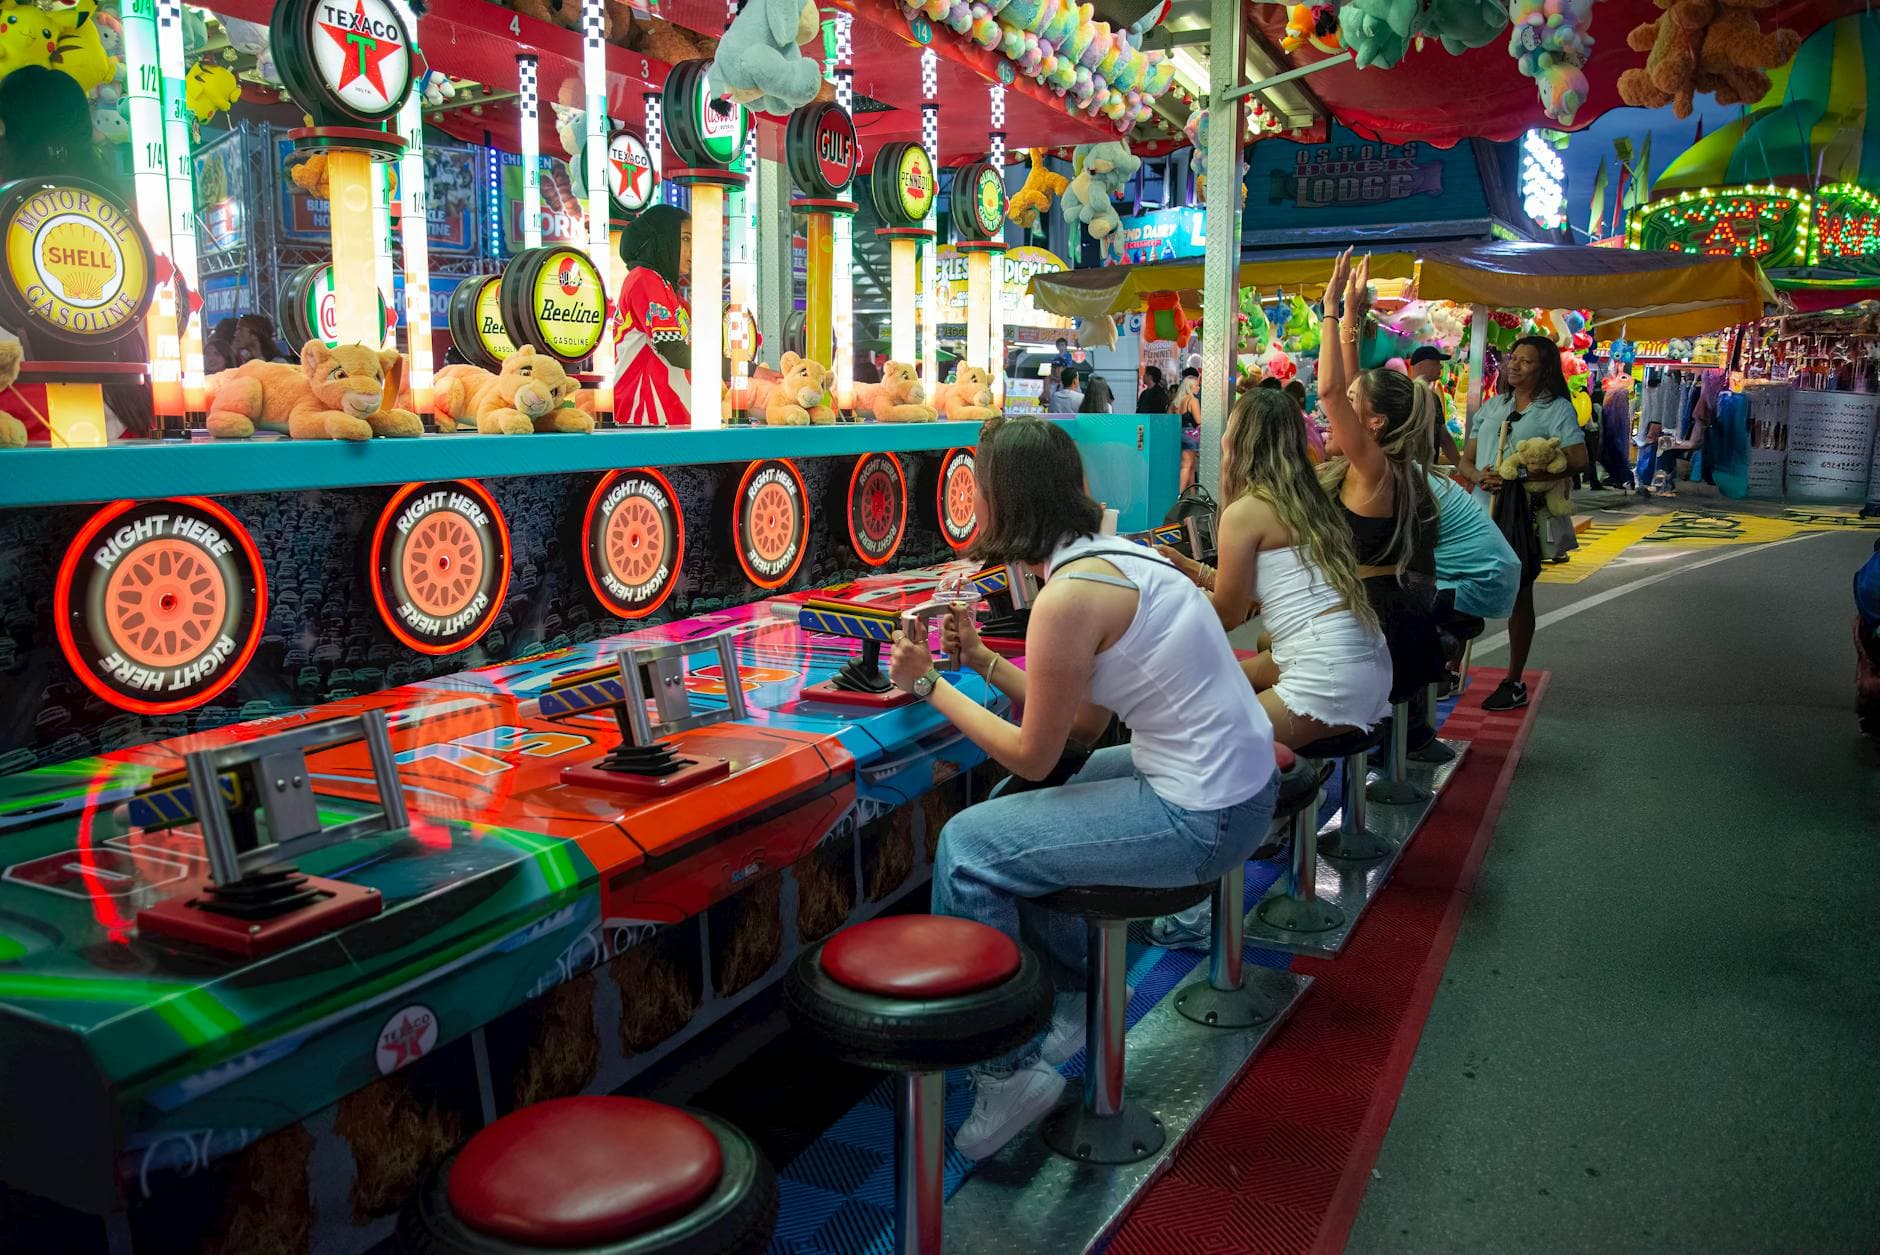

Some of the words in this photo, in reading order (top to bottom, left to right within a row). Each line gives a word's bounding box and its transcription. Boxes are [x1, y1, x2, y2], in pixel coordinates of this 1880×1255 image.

[324, 5, 398, 41] TEXACO
[510, 15, 521, 36] 4
[915, 21, 928, 41] 14
[140, 64, 157, 92] 1/2
[641, 60, 650, 78] 3
[999, 64, 1012, 81] 15
[146, 142, 163, 169] 1/4
[502, 154, 552, 169] CHIEN
[612, 148, 648, 166] TEXACO
[821, 130, 852, 168] GULF
[1296, 174, 1413, 208] LODGE
[16, 190, 92, 235] MOTOR
[97, 204, 130, 242] OIL
[48, 246, 111, 269] SHELL
[26, 284, 137, 331] GASOLINE
[541, 299, 600, 323] Beeline
[554, 337, 589, 346] GASOLINE
[748, 468, 775, 500] RIGHT
[775, 469, 797, 496] HERE
[860, 459, 880, 486] RIGHT
[881, 460, 898, 482] HERE
[601, 480, 638, 516] RIGHT
[639, 480, 669, 510] HERE
[396, 491, 447, 535] RIGHT
[448, 492, 489, 528] HERE
[94, 515, 169, 570] RIGHT
[172, 515, 233, 557] HERE
[858, 530, 876, 552] HERE
[877, 524, 897, 552] RIGHT
[747, 549, 770, 575] HERE
[771, 543, 797, 575] RIGHT
[602, 573, 634, 602] HERE
[634, 564, 669, 602] RIGHT
[397, 602, 441, 636] HERE
[442, 592, 489, 636] RIGHT
[98, 652, 166, 692] HERE
[168, 634, 236, 691] RIGHT
